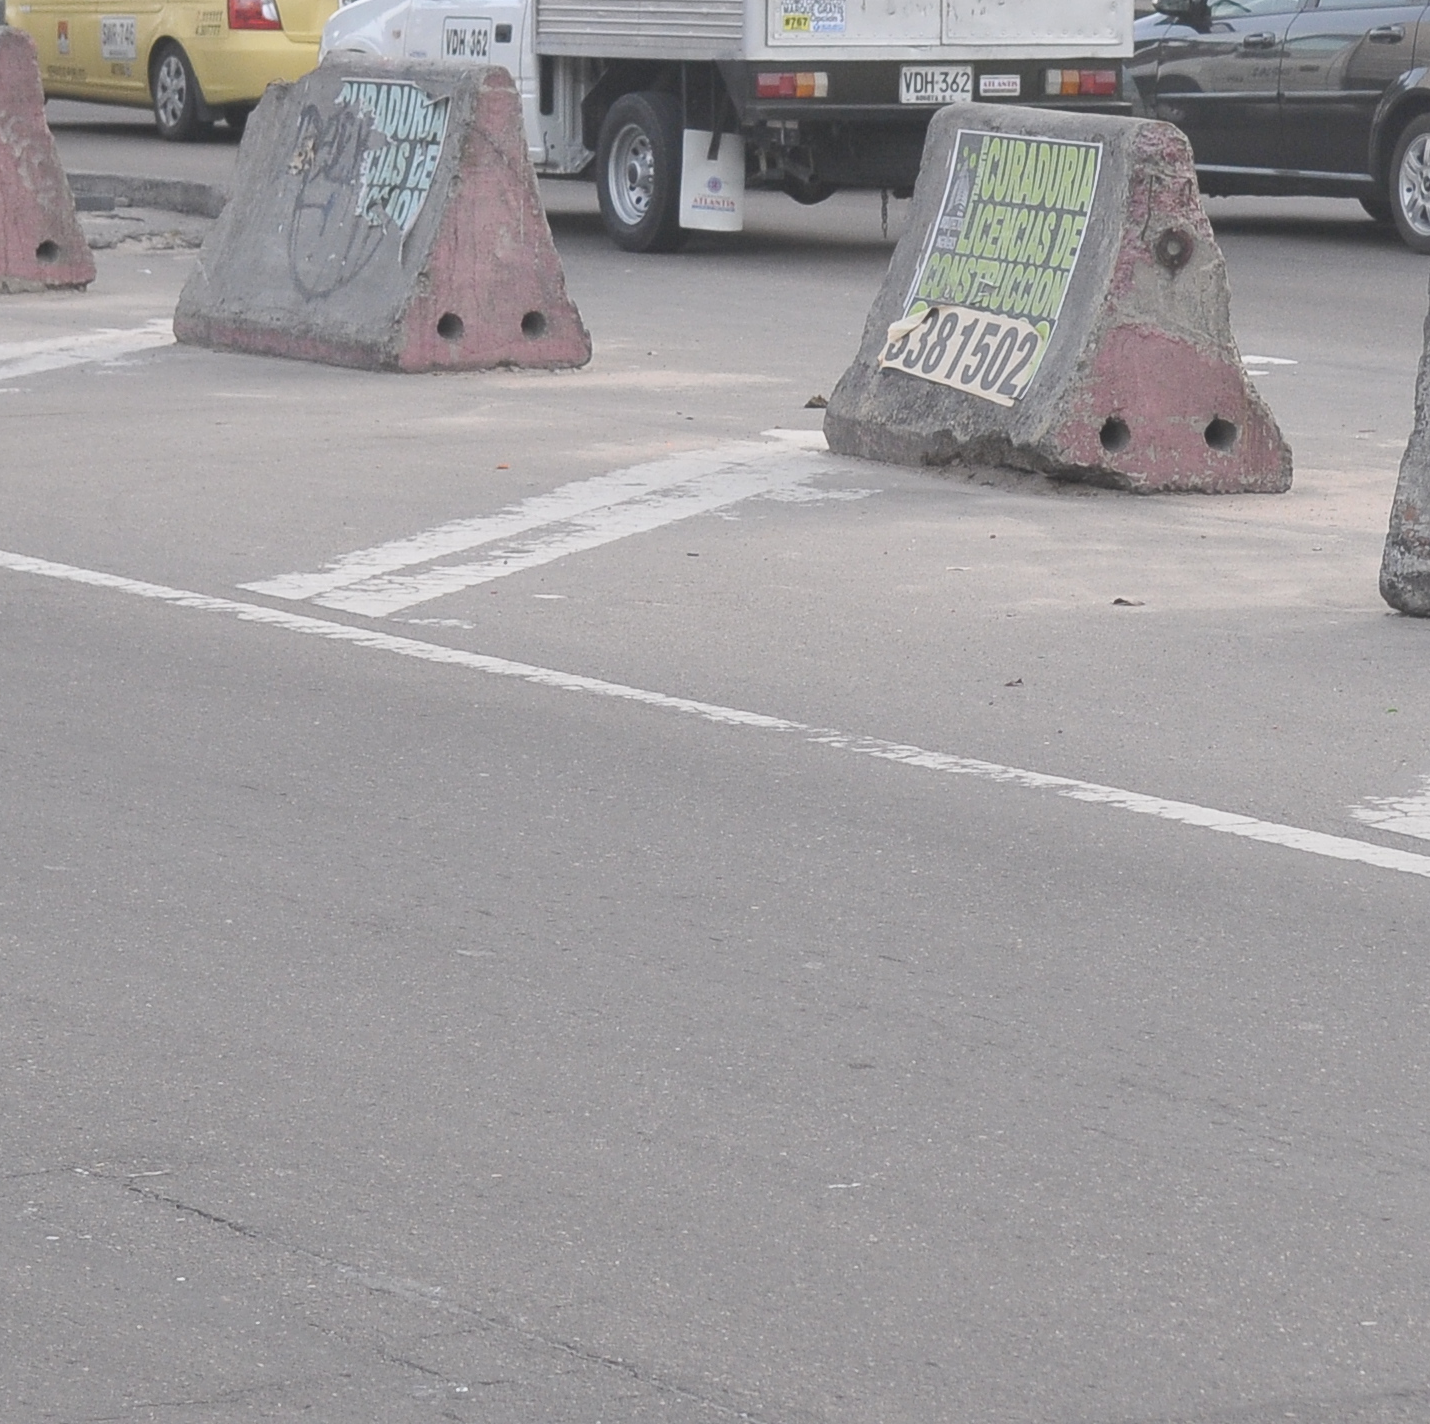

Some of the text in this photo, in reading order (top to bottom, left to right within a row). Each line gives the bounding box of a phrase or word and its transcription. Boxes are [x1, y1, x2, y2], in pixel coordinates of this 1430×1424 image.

[784, 16, 809, 29] #767
[983, 80, 1018, 88] ATLANTIS
[982, 137, 1096, 212] CURADURIA
[692, 196, 736, 208] ATLANTIS
[955, 203, 1087, 270] LICENCIAS DE
[918, 252, 1069, 320] CONSTRUCCION
